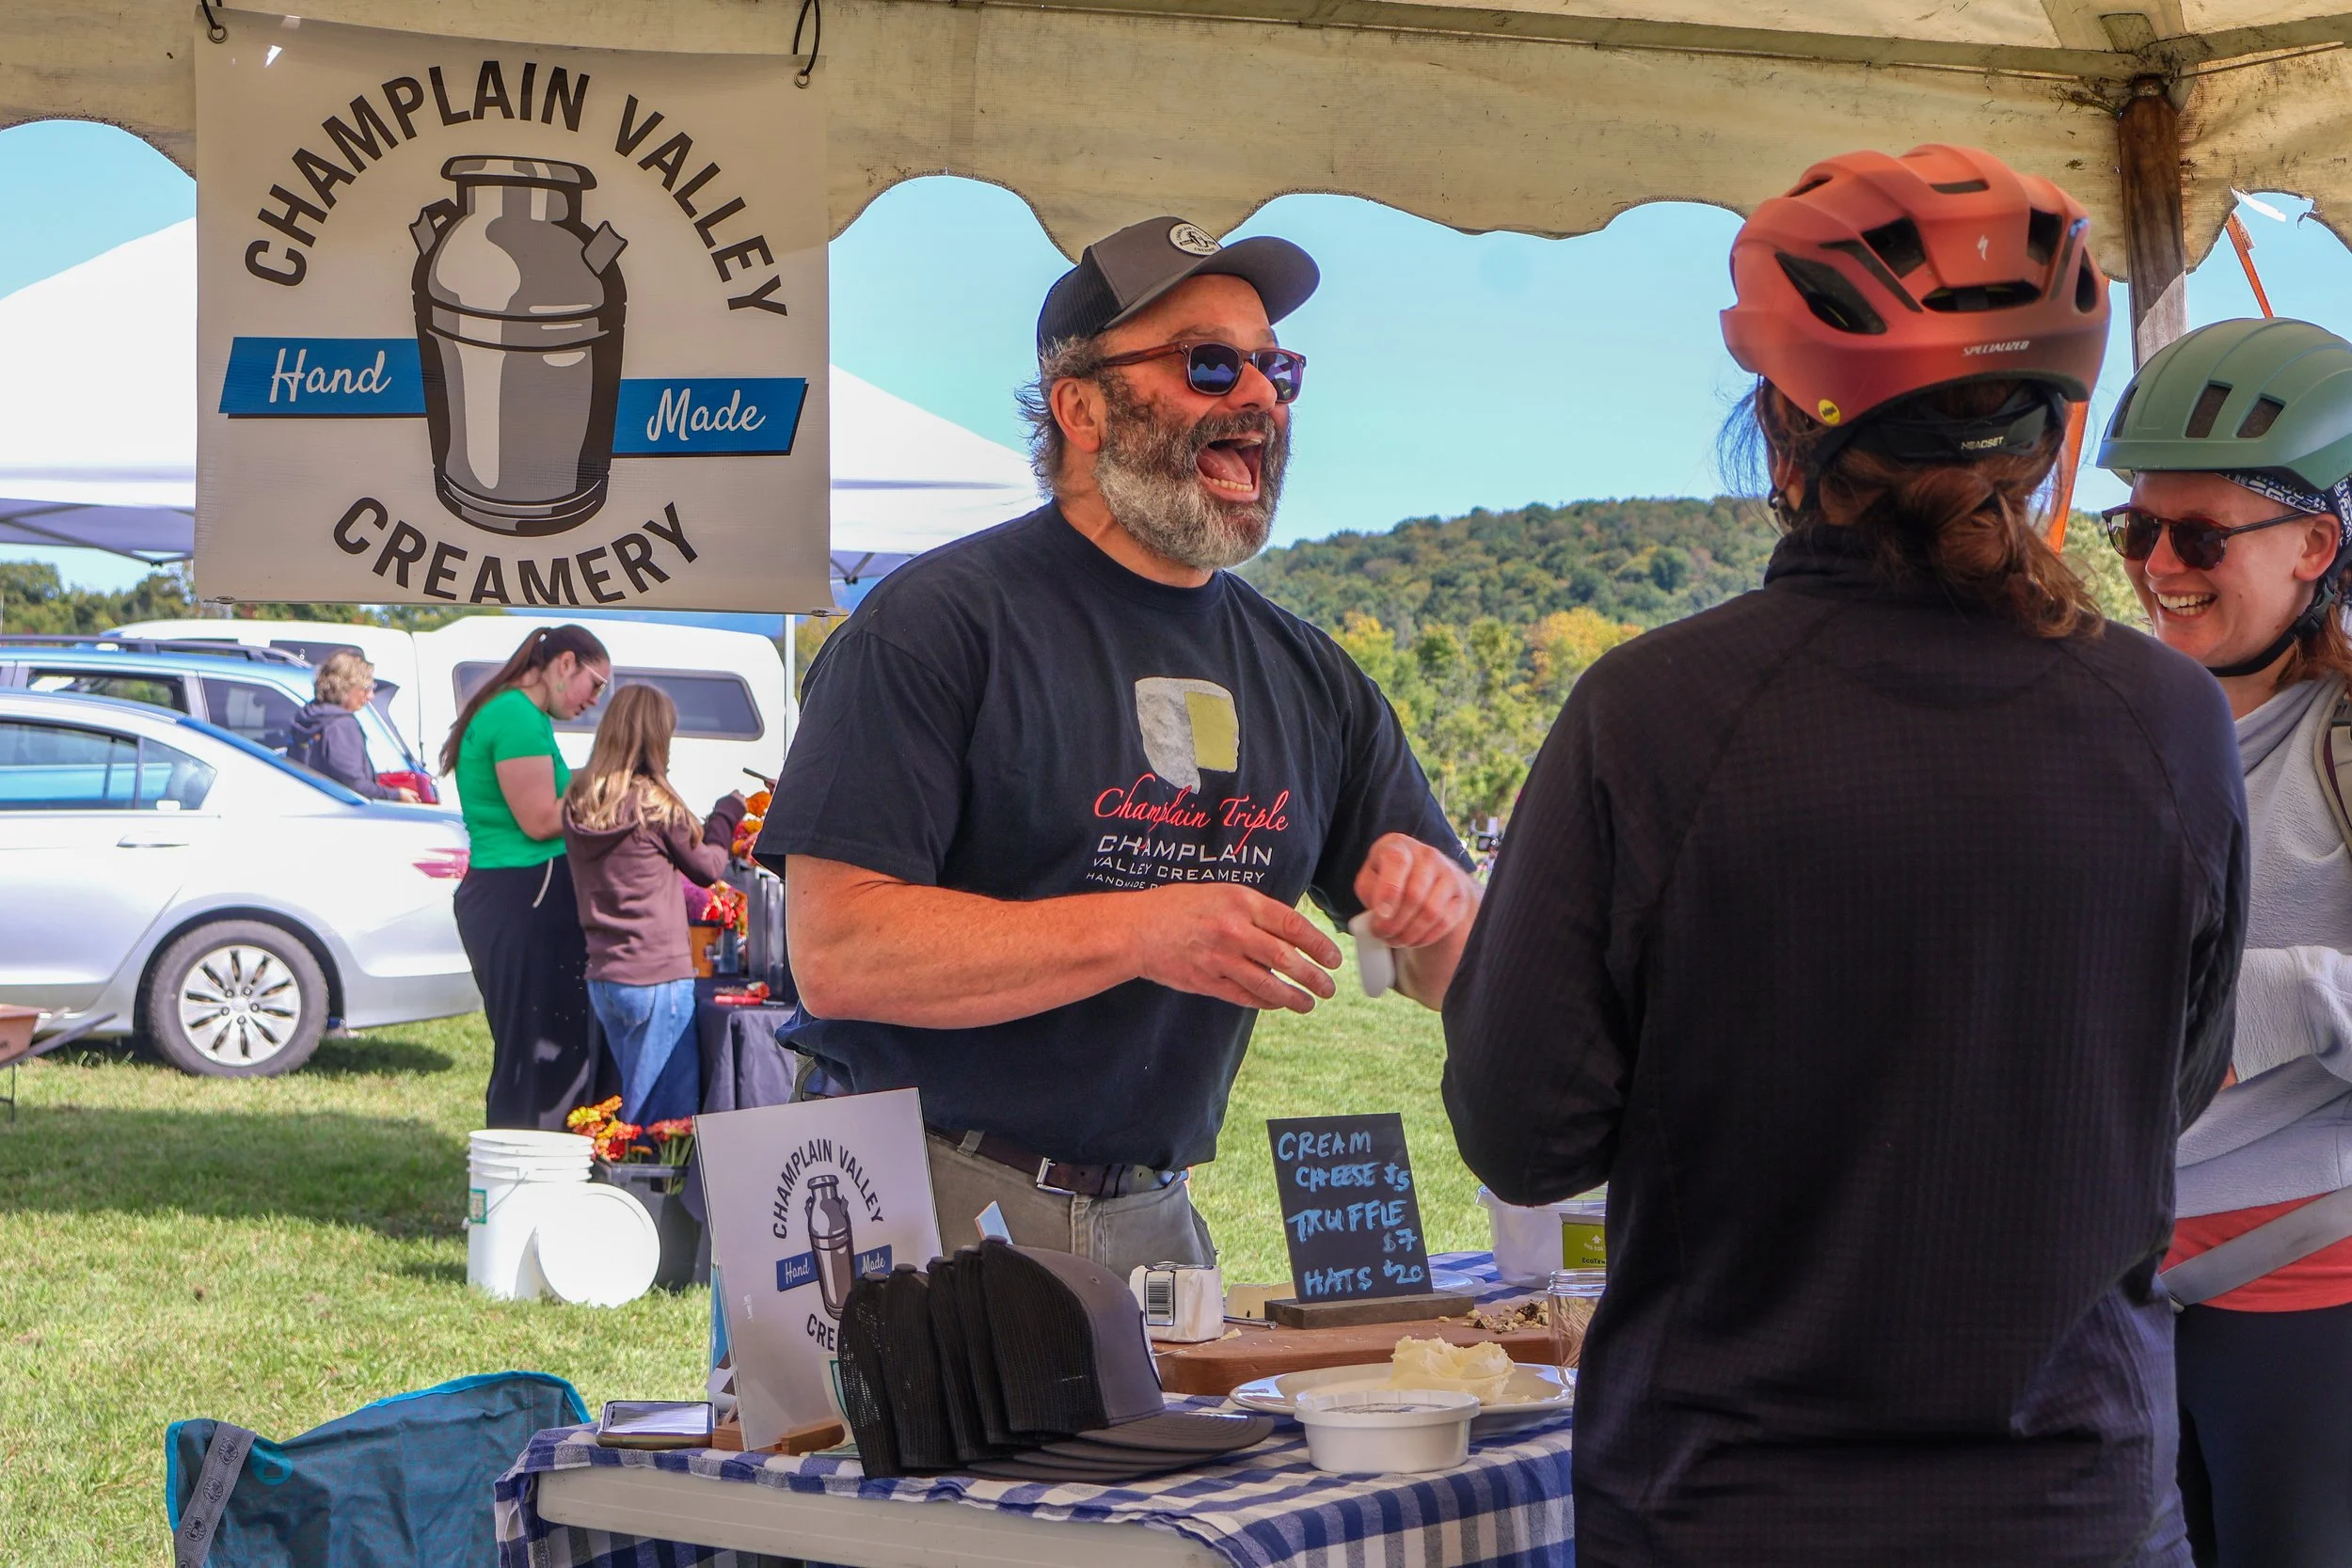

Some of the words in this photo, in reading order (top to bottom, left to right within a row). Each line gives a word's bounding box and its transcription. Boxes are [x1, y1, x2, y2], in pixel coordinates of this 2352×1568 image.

[245, 60, 591, 288] CHAMPLAIN
[614, 94, 788, 318] VALLEY
[1963, 341, 2029, 356] SPECIALIZED
[269, 347, 391, 404] Hand
[646, 388, 767, 442] Made
[1962, 436, 2004, 450] HEADSET
[331, 496, 699, 607] CREAMERY
[1093, 771, 1212, 850] Champlain
[1219, 789, 1291, 856] Triple
[1096, 834, 1274, 867] CHAMPLAIN
[1092, 856, 1152, 875] VALLEY
[1156, 865, 1266, 884] CREAMERY
[1278, 1131, 1372, 1162] CREAM
[772, 1138, 833, 1240] CHAMPLAIN
[839, 1144, 884, 1223] VALLEY
[1295, 1162, 1382, 1193] CHEESE
[1384, 1163, 1410, 1192] $5
[1286, 1199, 1408, 1243] TRUFFLE
[1382, 1227, 1419, 1253] $7
[785, 1257, 811, 1285] Hand
[861, 1251, 886, 1274] Made
[1303, 1265, 1374, 1298] HATS
[1382, 1258, 1425, 1284] $20
